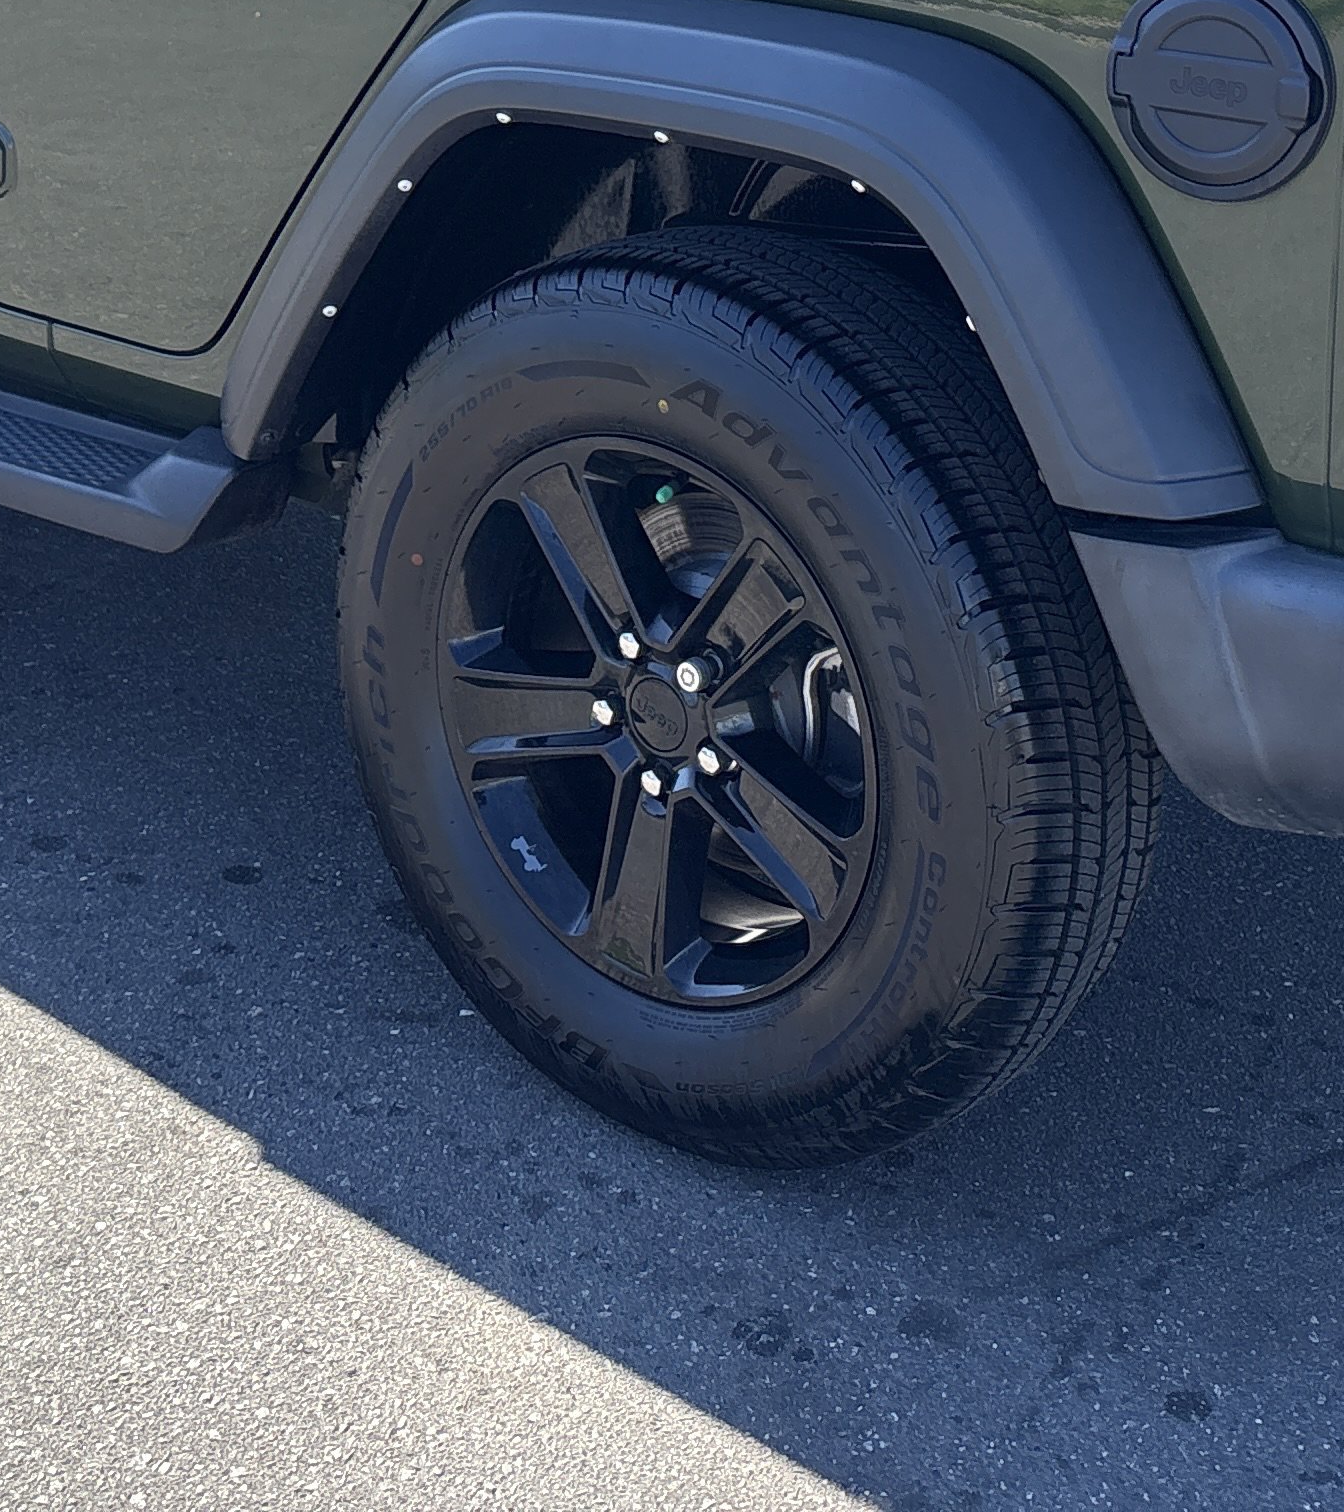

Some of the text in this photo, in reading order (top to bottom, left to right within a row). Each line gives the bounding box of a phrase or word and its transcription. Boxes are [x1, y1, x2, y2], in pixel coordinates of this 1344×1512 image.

[1169, 66, 1249, 108] Jeep
[668, 378, 943, 825] Advantage
[362, 623, 609, 1072] BFGoodrich
